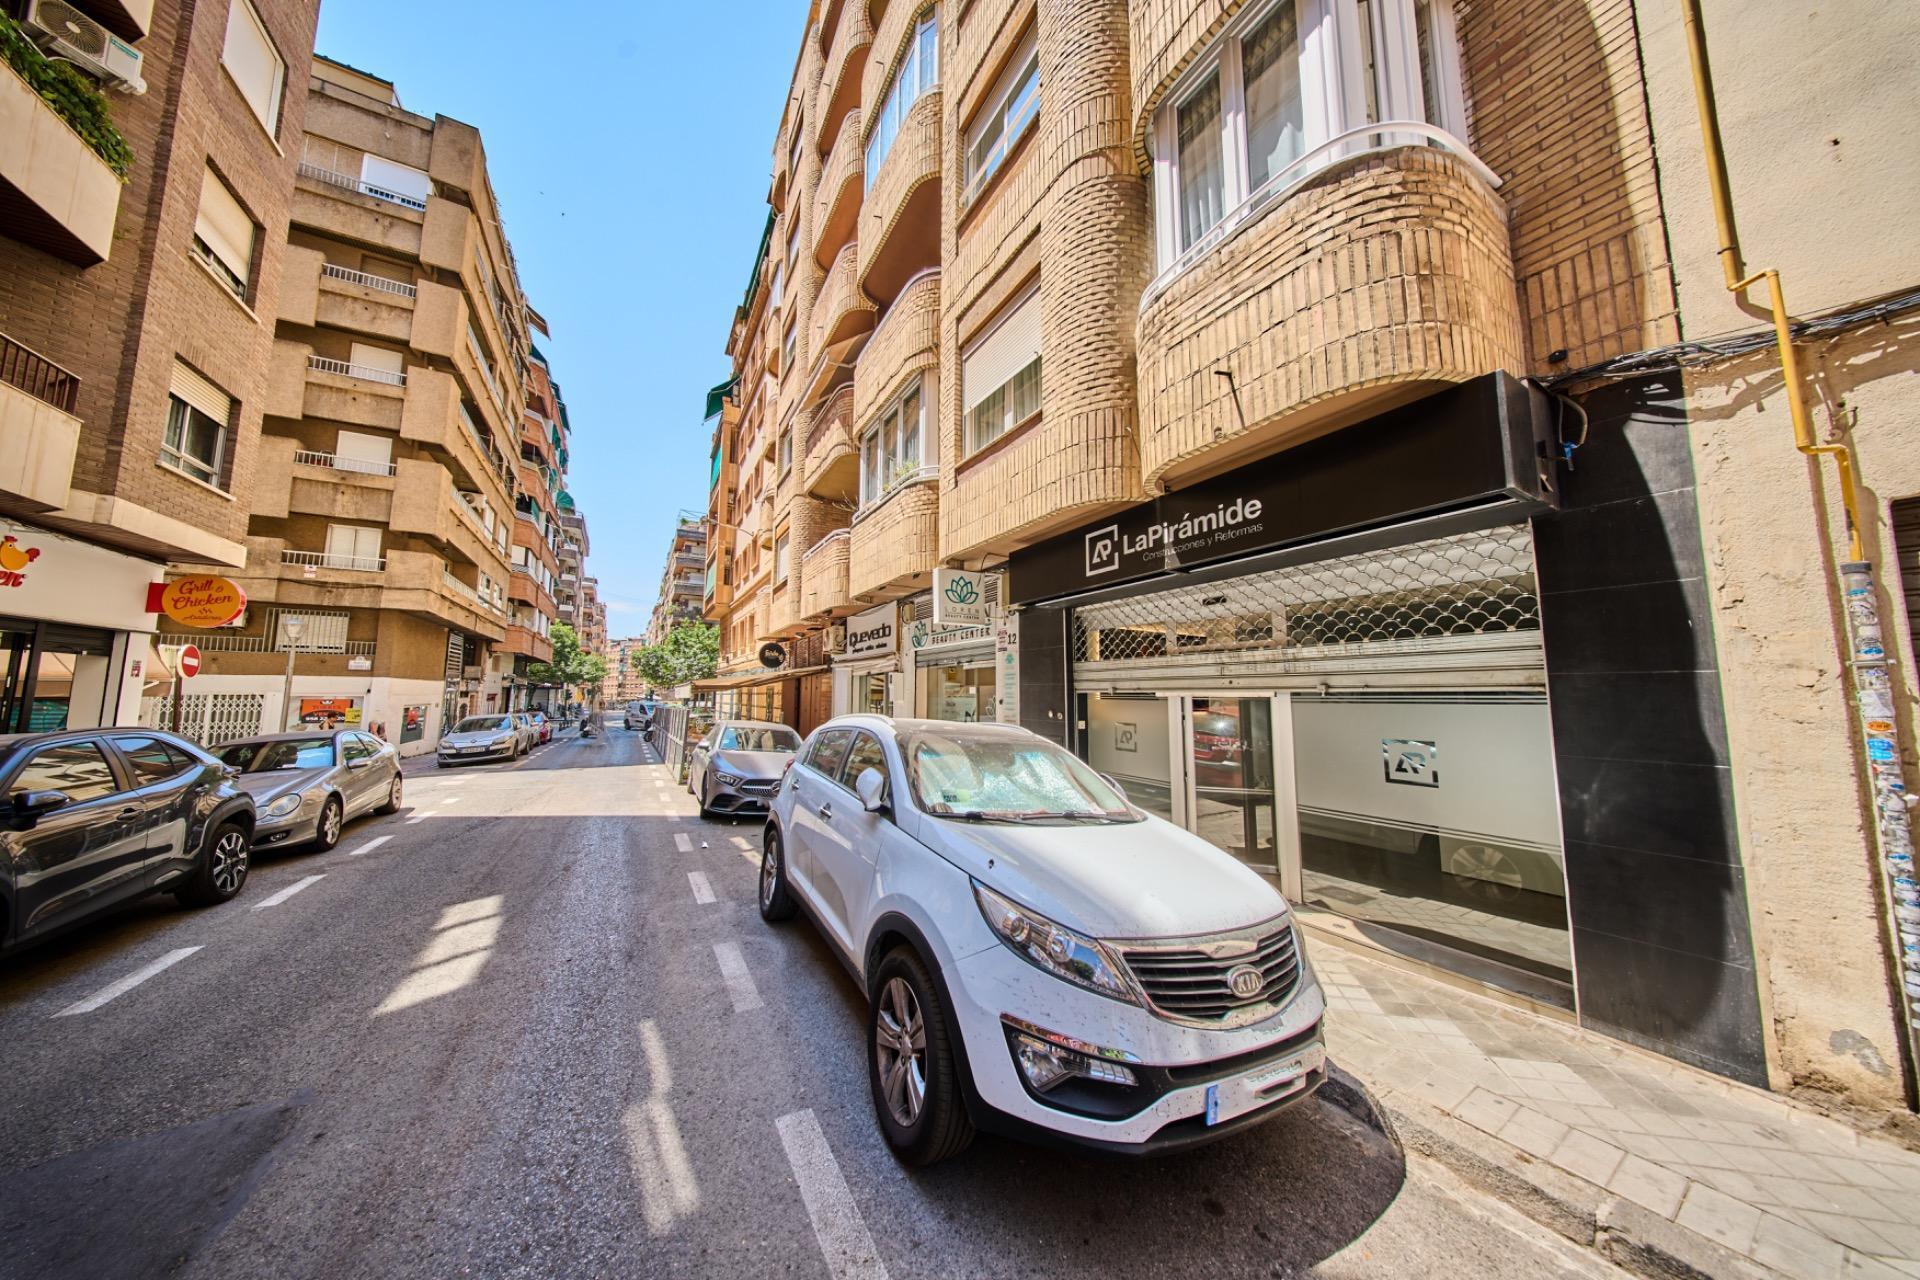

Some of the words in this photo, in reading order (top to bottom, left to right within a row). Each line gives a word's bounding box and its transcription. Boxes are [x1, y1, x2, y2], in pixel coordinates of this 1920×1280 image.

[1123, 498, 1262, 555] LaPirámide
[1142, 538, 1205, 562] Construcciones
[1207, 537, 1213, 547] y
[1215, 522, 1263, 543] Reformas
[179, 580, 213, 595] Grill
[172, 593, 233, 610] Chicken
[849, 622, 892, 648] Quevedo
[931, 634, 956, 645] BEAUTY
[961, 627, 991, 640] CENTER
[1007, 632, 1017, 645] 12
[1236, 973, 1259, 991] KIA
